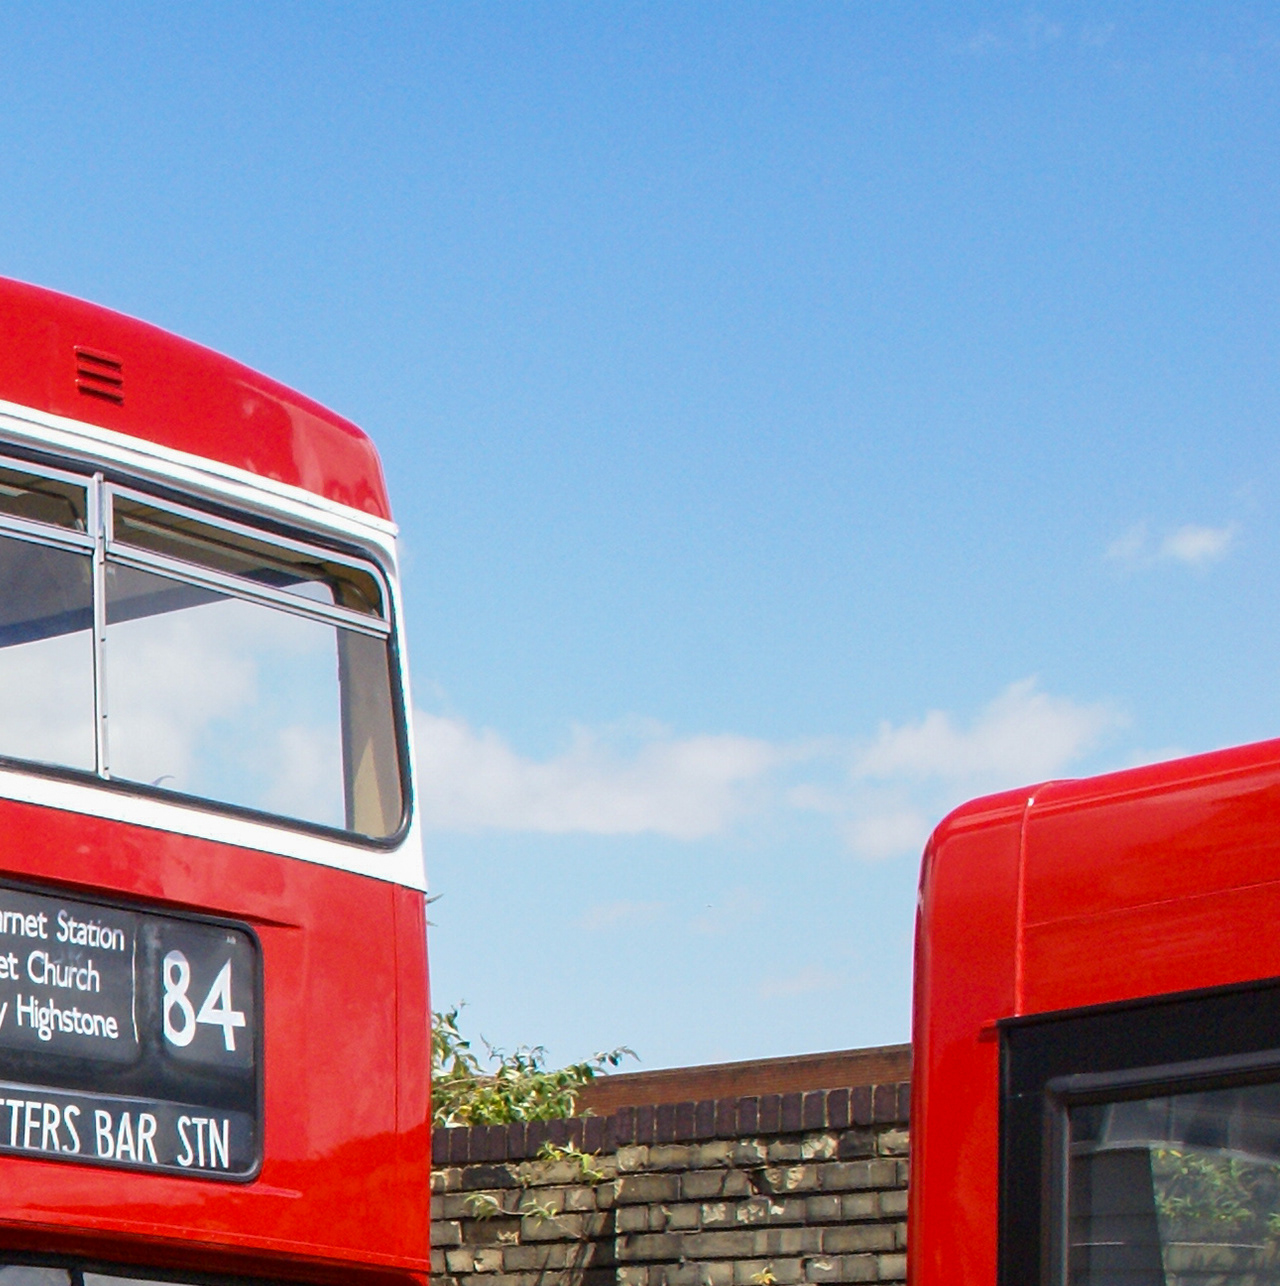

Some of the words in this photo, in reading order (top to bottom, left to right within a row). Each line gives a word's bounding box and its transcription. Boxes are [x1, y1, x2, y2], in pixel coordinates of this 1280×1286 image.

[56, 909, 125, 951] Station
[27, 950, 101, 993] Church
[16, 993, 120, 1042] Highstone
[162, 949, 246, 1052] 84
[93, 1109, 158, 1164] BAR
[176, 1115, 229, 1169] STN
